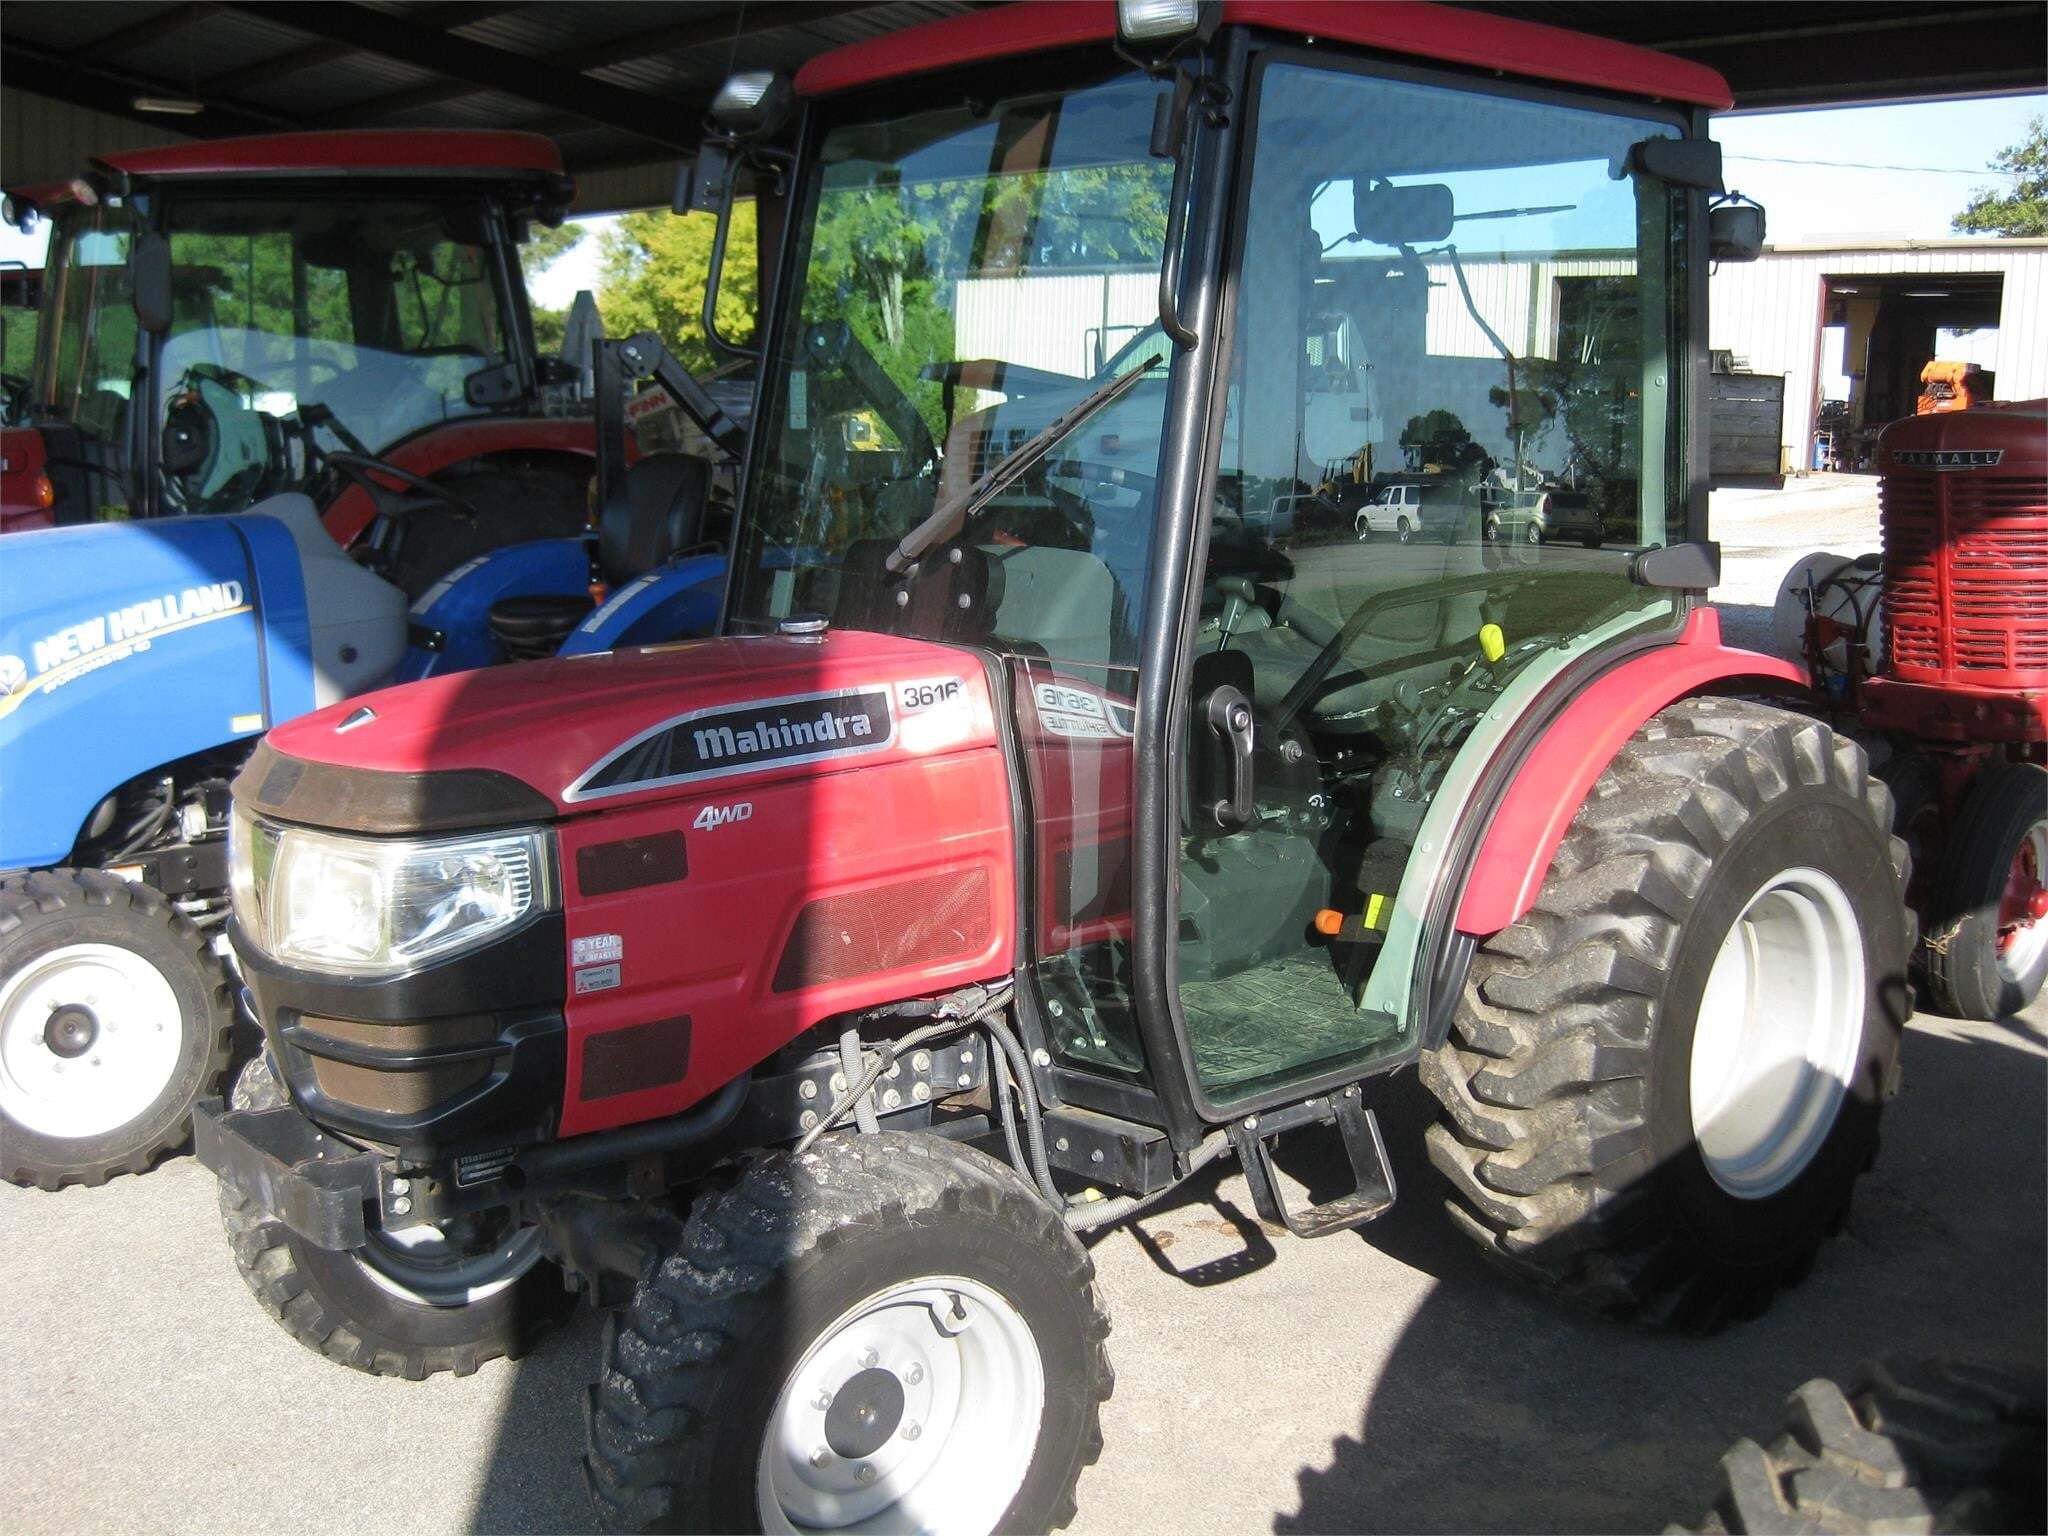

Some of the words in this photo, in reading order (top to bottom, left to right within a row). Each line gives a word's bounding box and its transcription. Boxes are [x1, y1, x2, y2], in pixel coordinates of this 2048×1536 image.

[34, 616, 106, 672] NEW
[108, 580, 244, 642] HOLLAND
[693, 711, 872, 760] Mahindra
[693, 802, 753, 832] 4WD
[590, 936, 617, 949] YEAR
